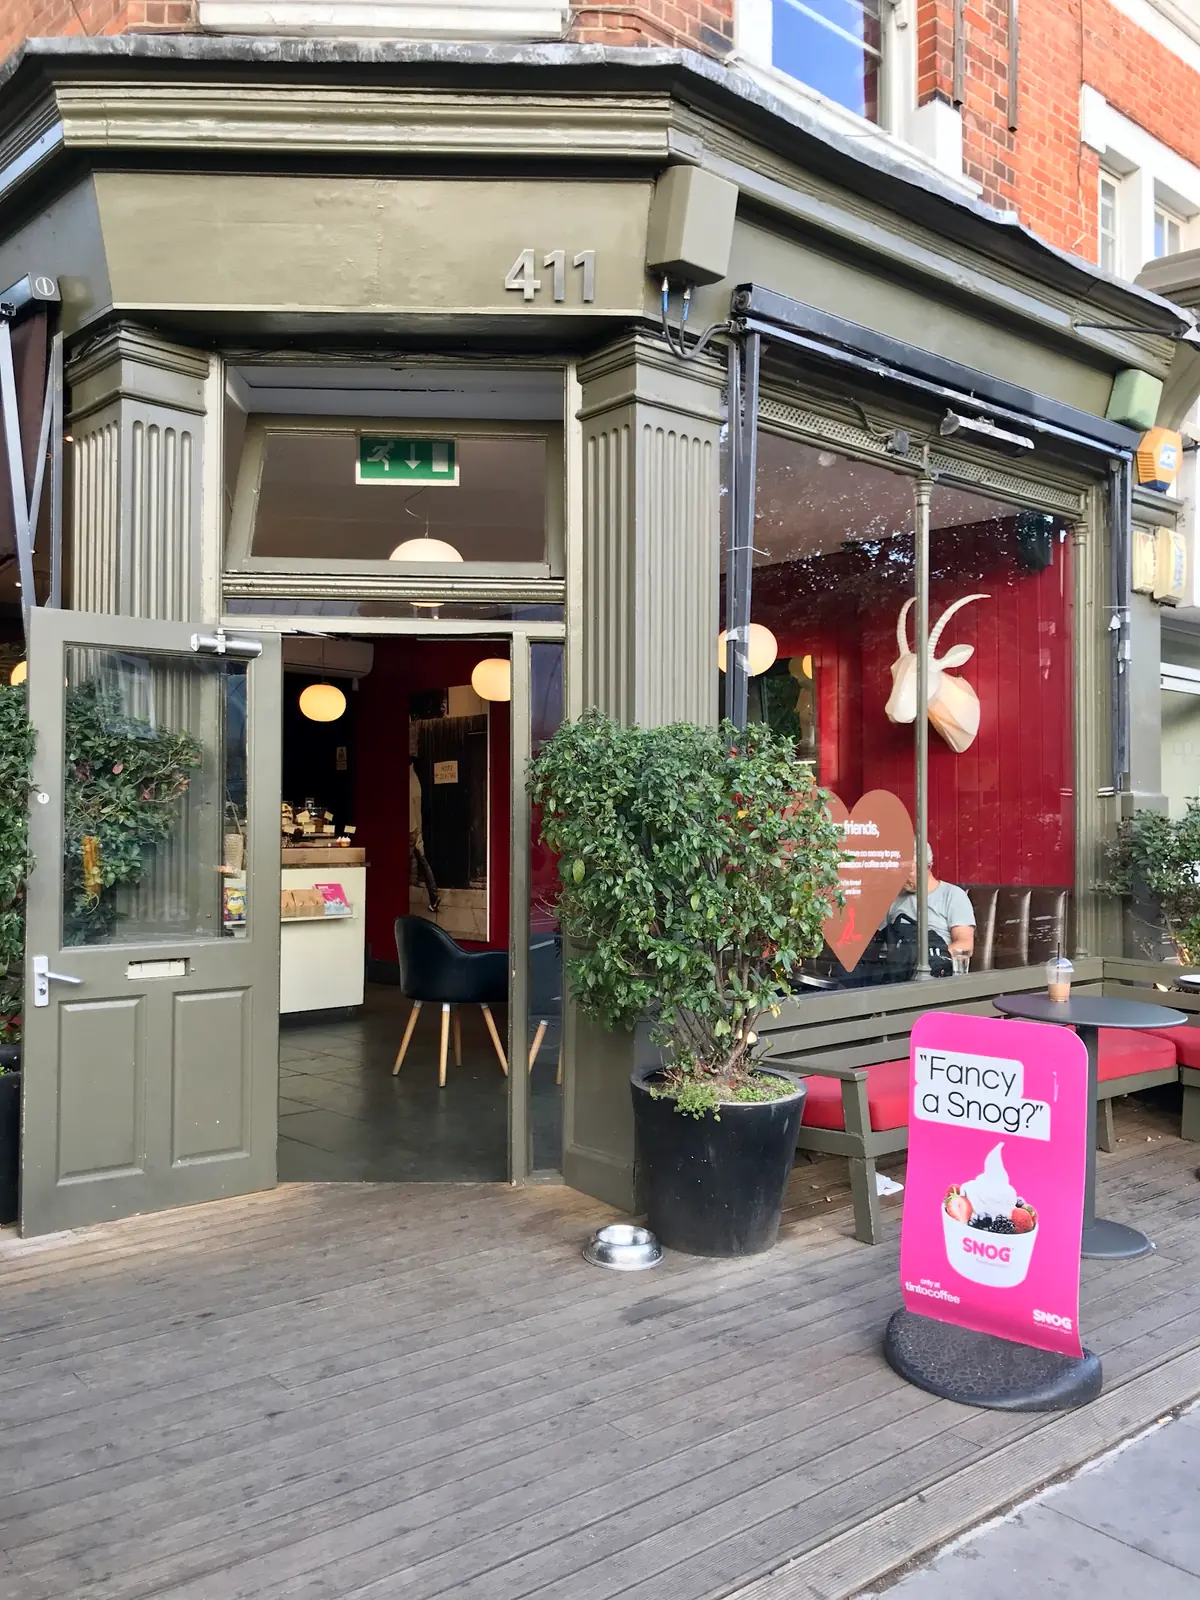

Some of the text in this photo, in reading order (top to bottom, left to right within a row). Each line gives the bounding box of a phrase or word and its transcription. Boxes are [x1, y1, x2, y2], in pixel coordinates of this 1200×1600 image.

[504, 248, 595, 301] 411
[843, 820, 880, 838] friends,
[922, 1093, 939, 1114] a
[962, 1237, 1011, 1263] SNOG
[904, 1280, 961, 1304] tintocoffee
[1032, 1309, 1073, 1331] SNOG
